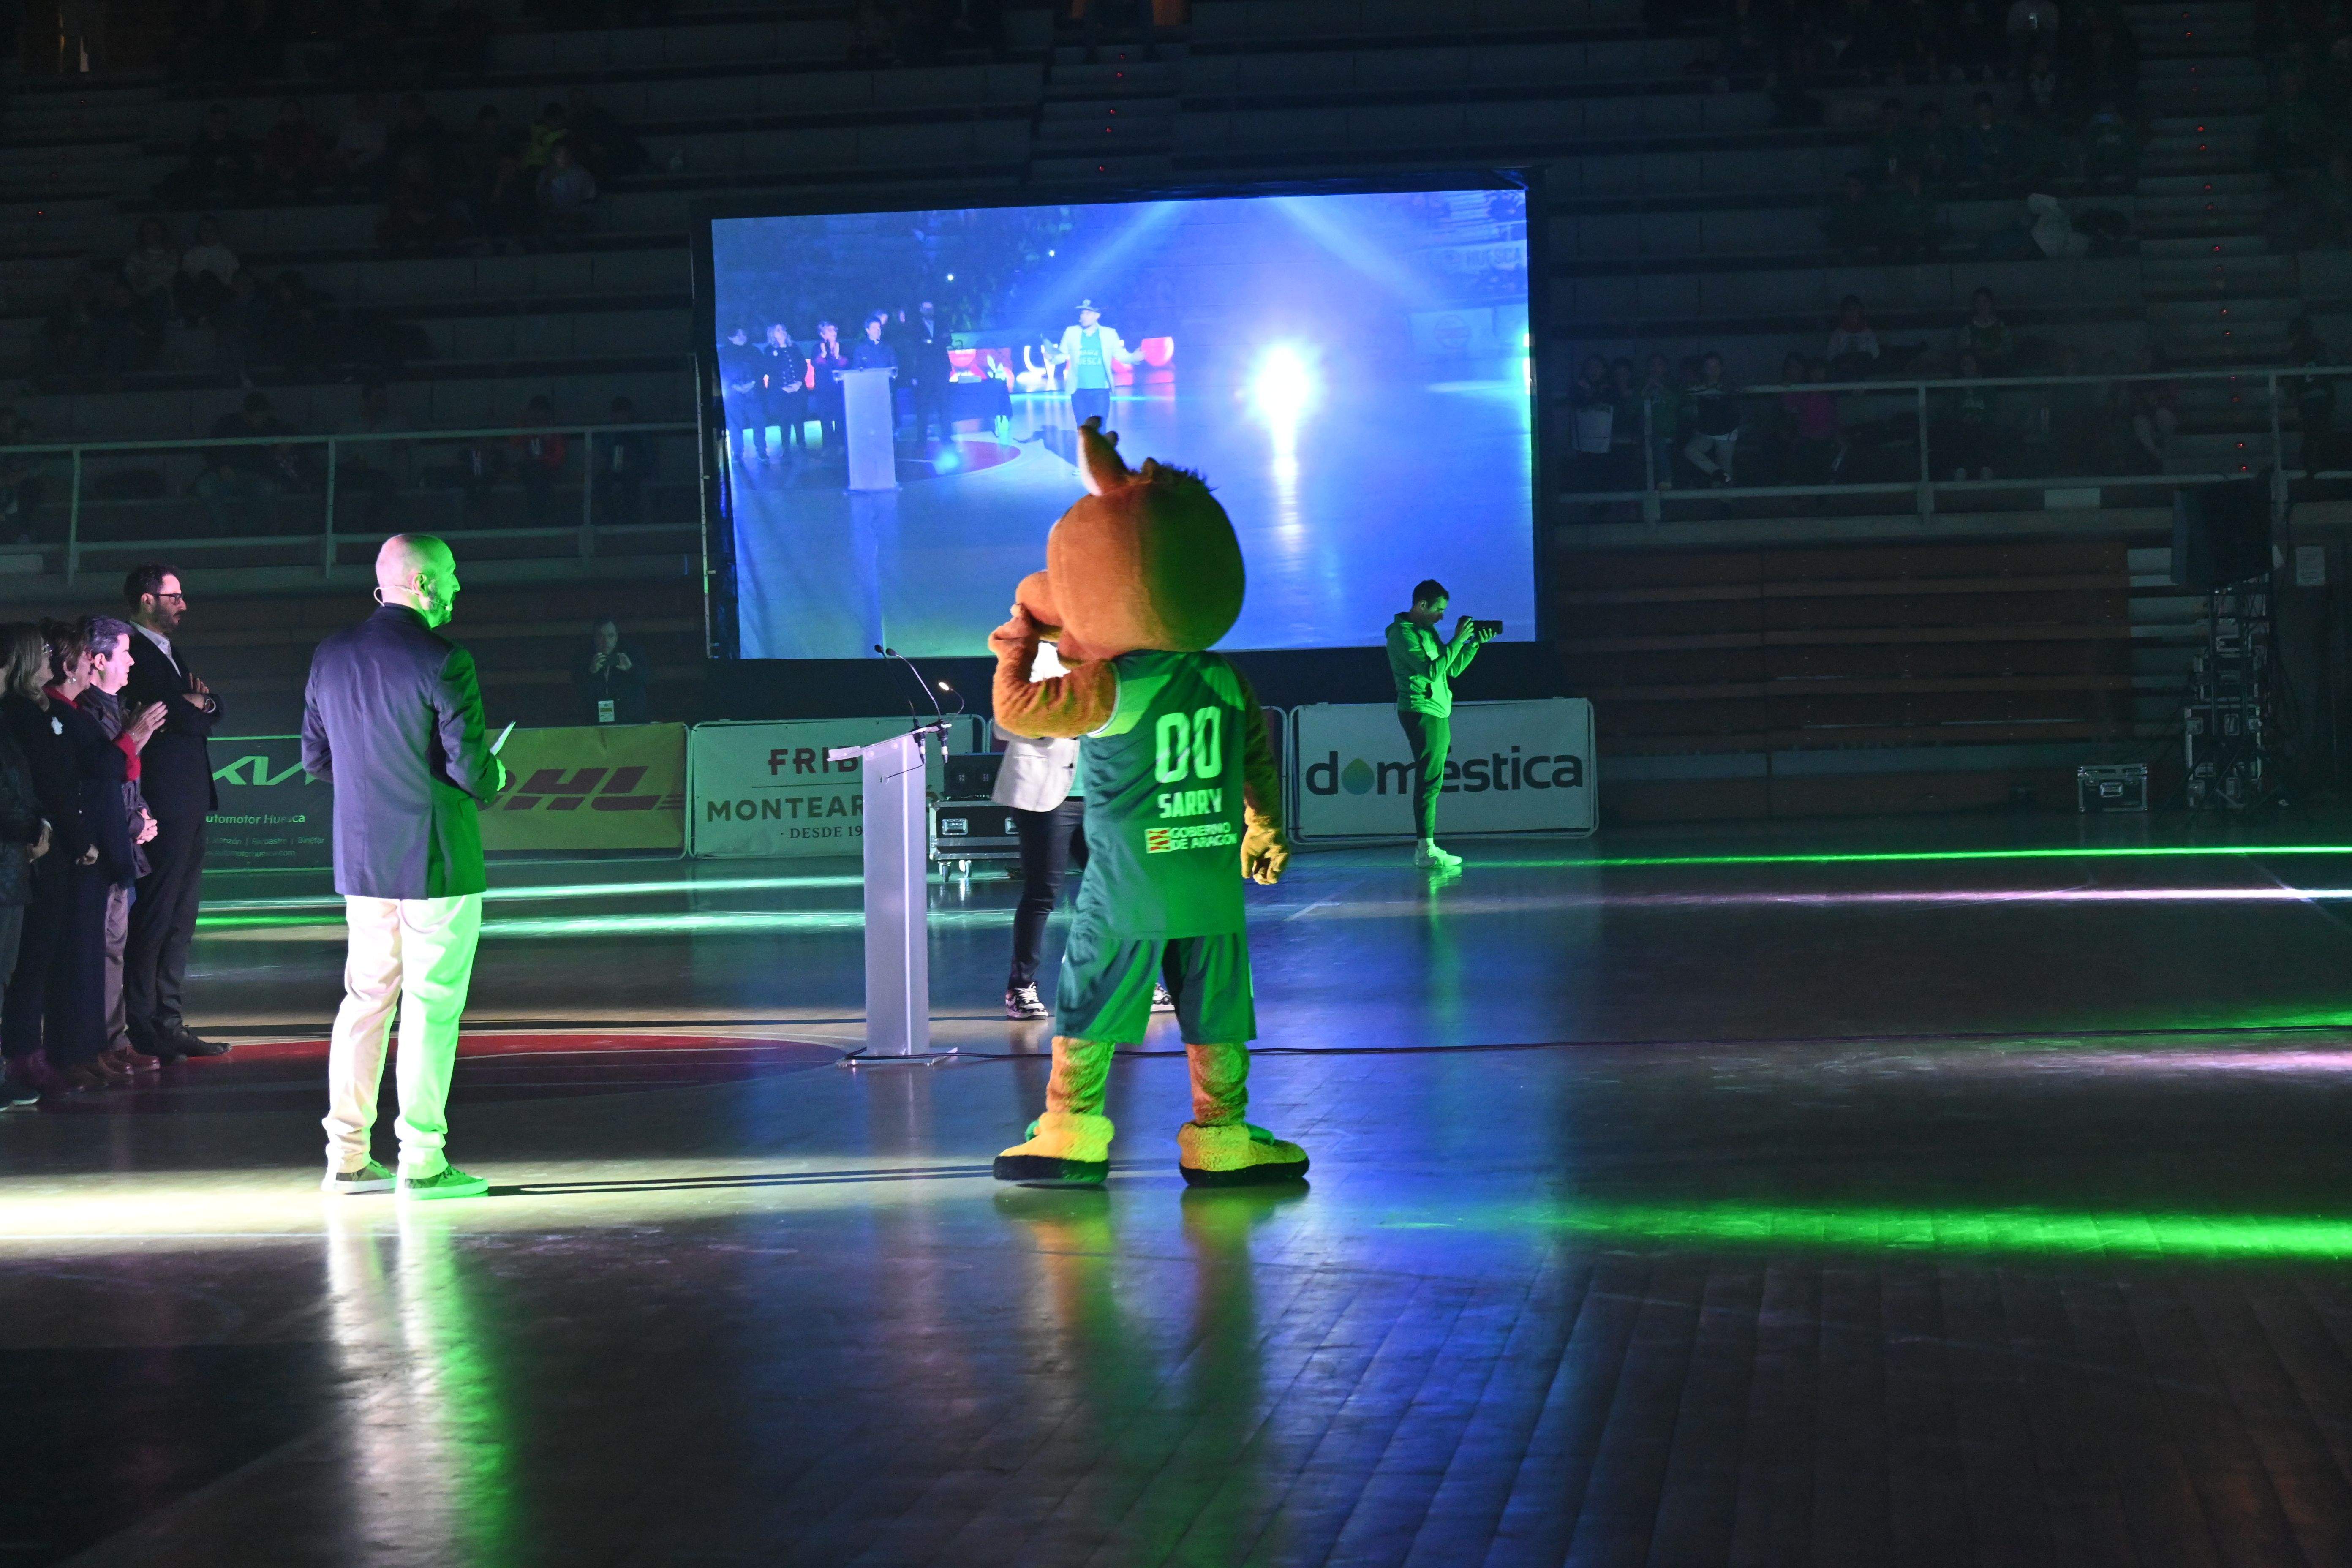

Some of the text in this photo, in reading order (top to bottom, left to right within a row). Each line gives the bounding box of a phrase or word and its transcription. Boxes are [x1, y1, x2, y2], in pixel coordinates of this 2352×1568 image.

[1155, 706, 1222, 783] 00
[768, 746, 871, 775] FRIB
[1158, 788, 1222, 818] SARRY
[205, 814, 306, 824] utomotor Huesca
[790, 826, 863, 838] DESDE 19
[1171, 822, 1231, 838] GOBIERNO
[1171, 837, 1188, 851] DE
